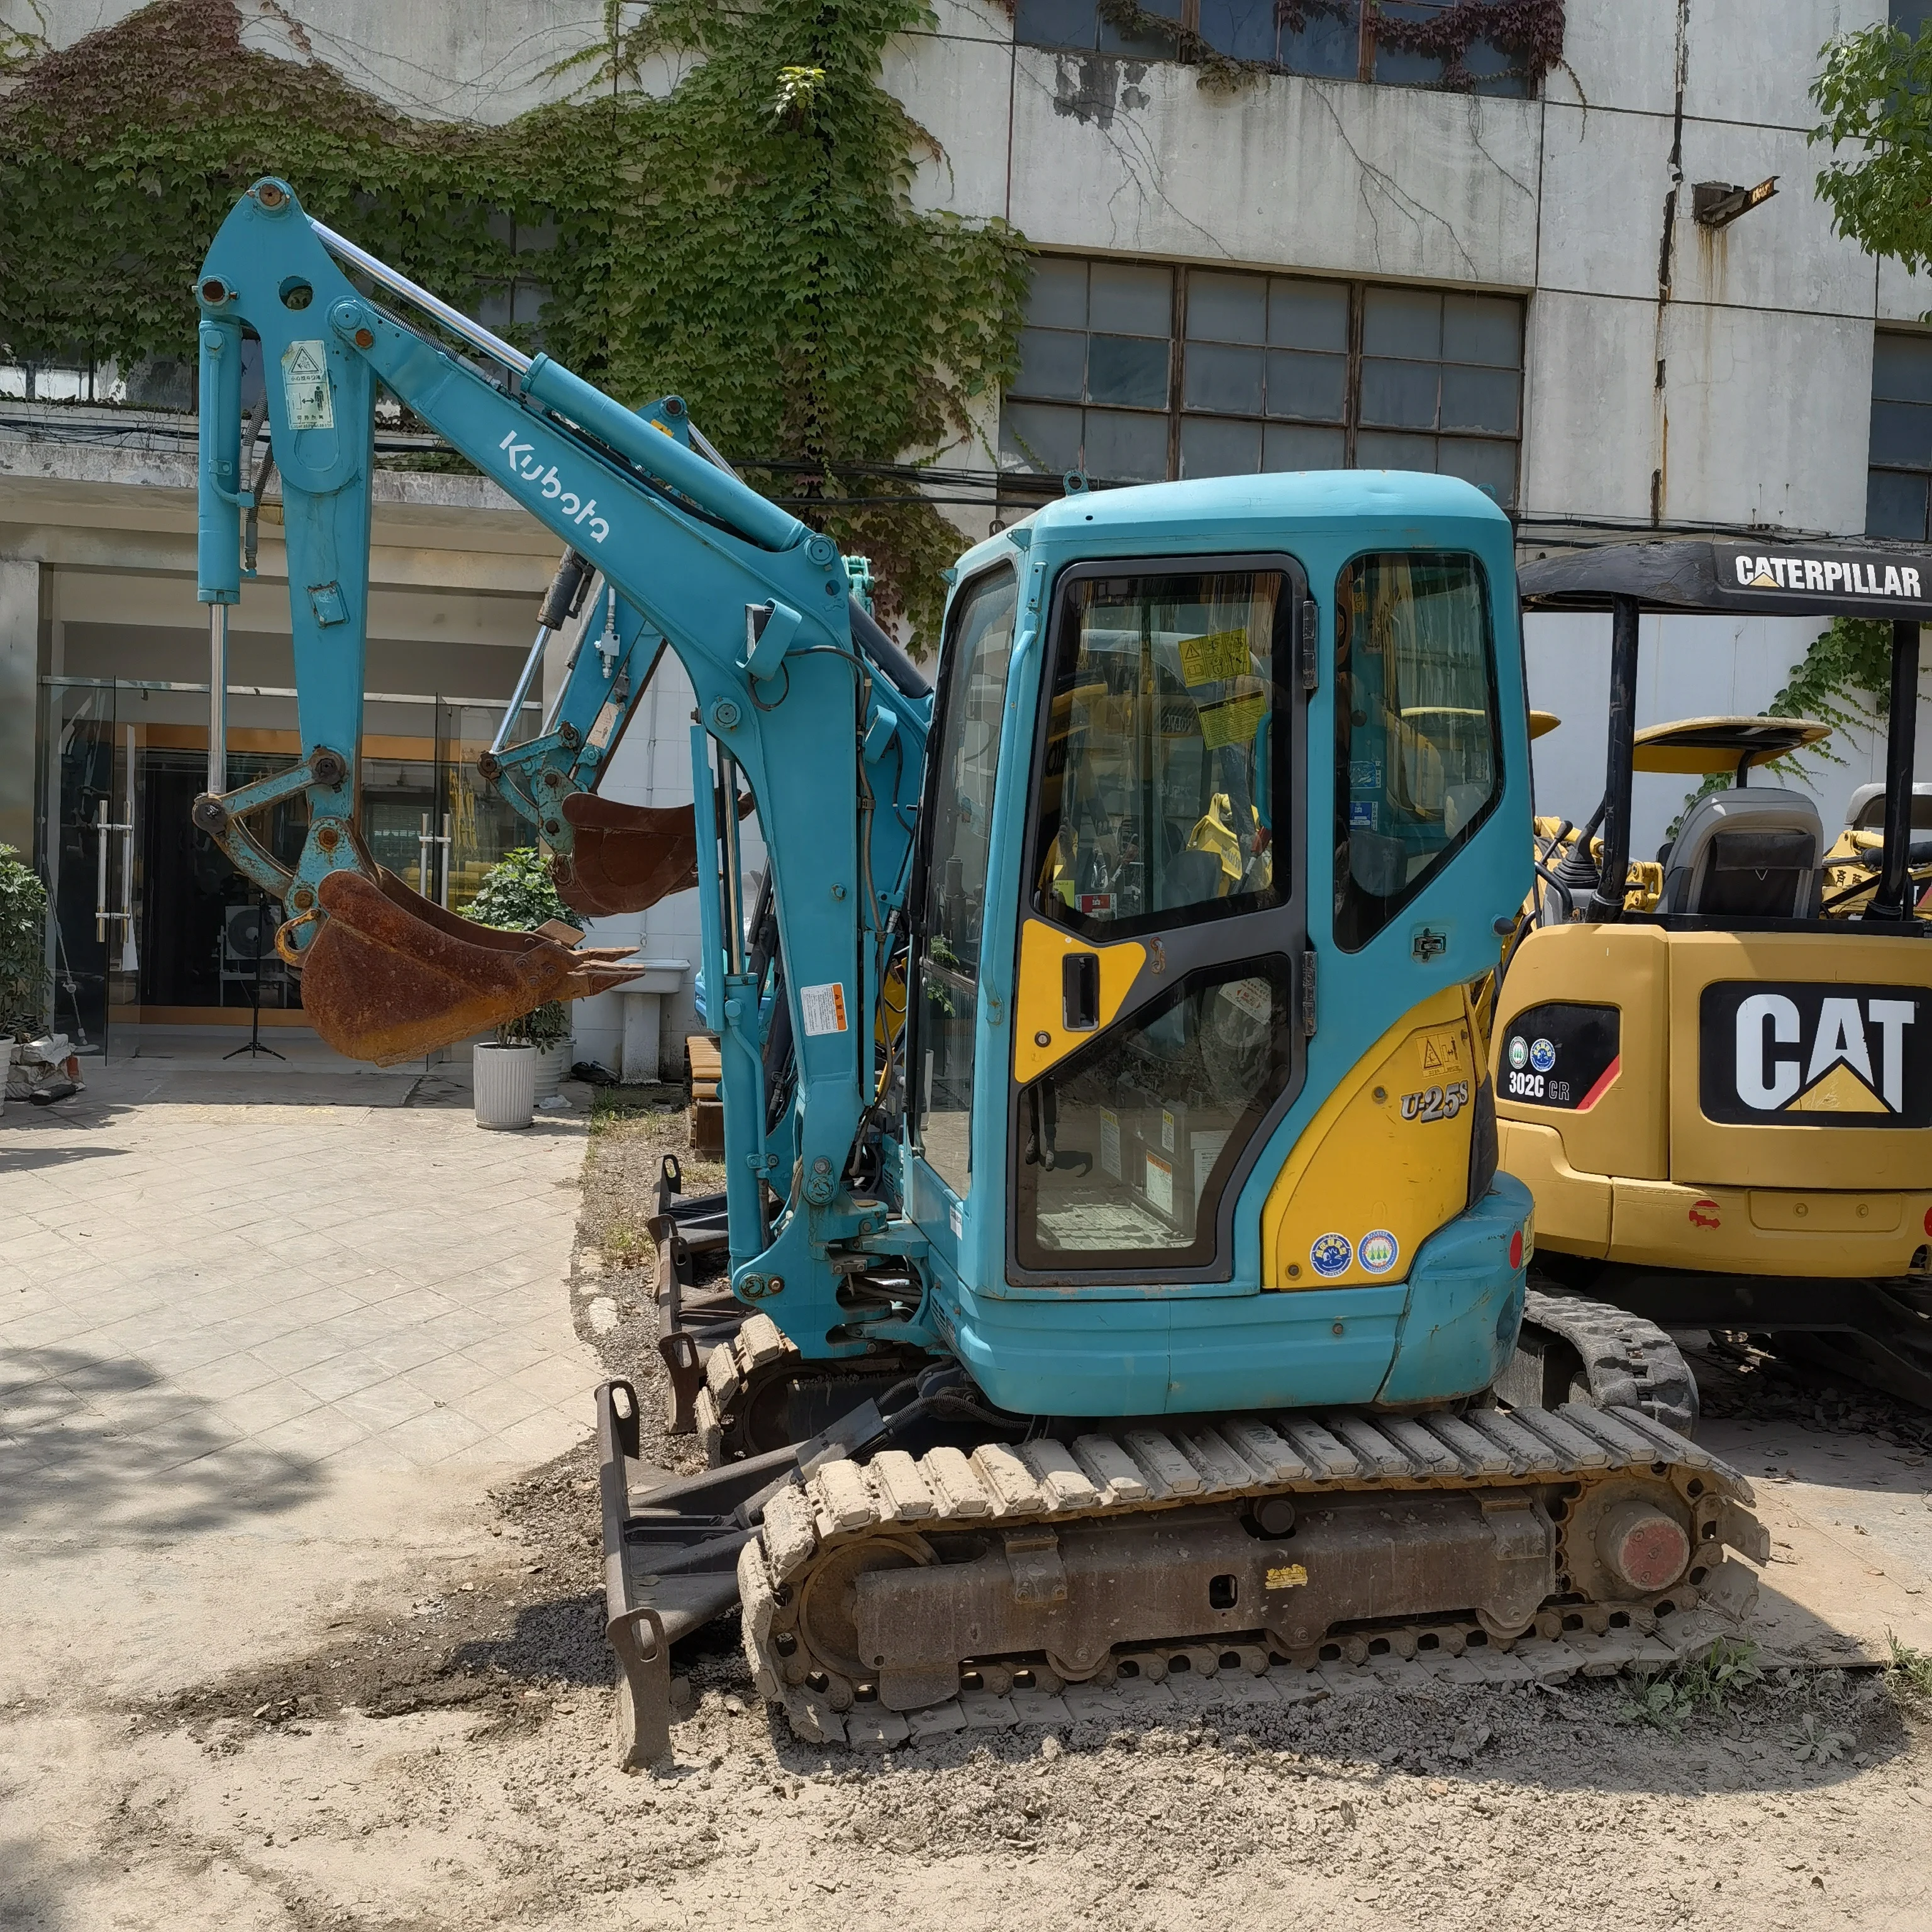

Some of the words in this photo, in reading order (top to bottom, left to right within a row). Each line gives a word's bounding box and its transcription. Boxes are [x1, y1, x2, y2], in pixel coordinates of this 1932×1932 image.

[499, 430, 609, 543] Kubota
[1735, 555, 1921, 597] CATERPILLAR
[1509, 1071, 1544, 1097] 302C
[1548, 1080, 1570, 1101] CR
[1736, 994, 1915, 1113] CAT
